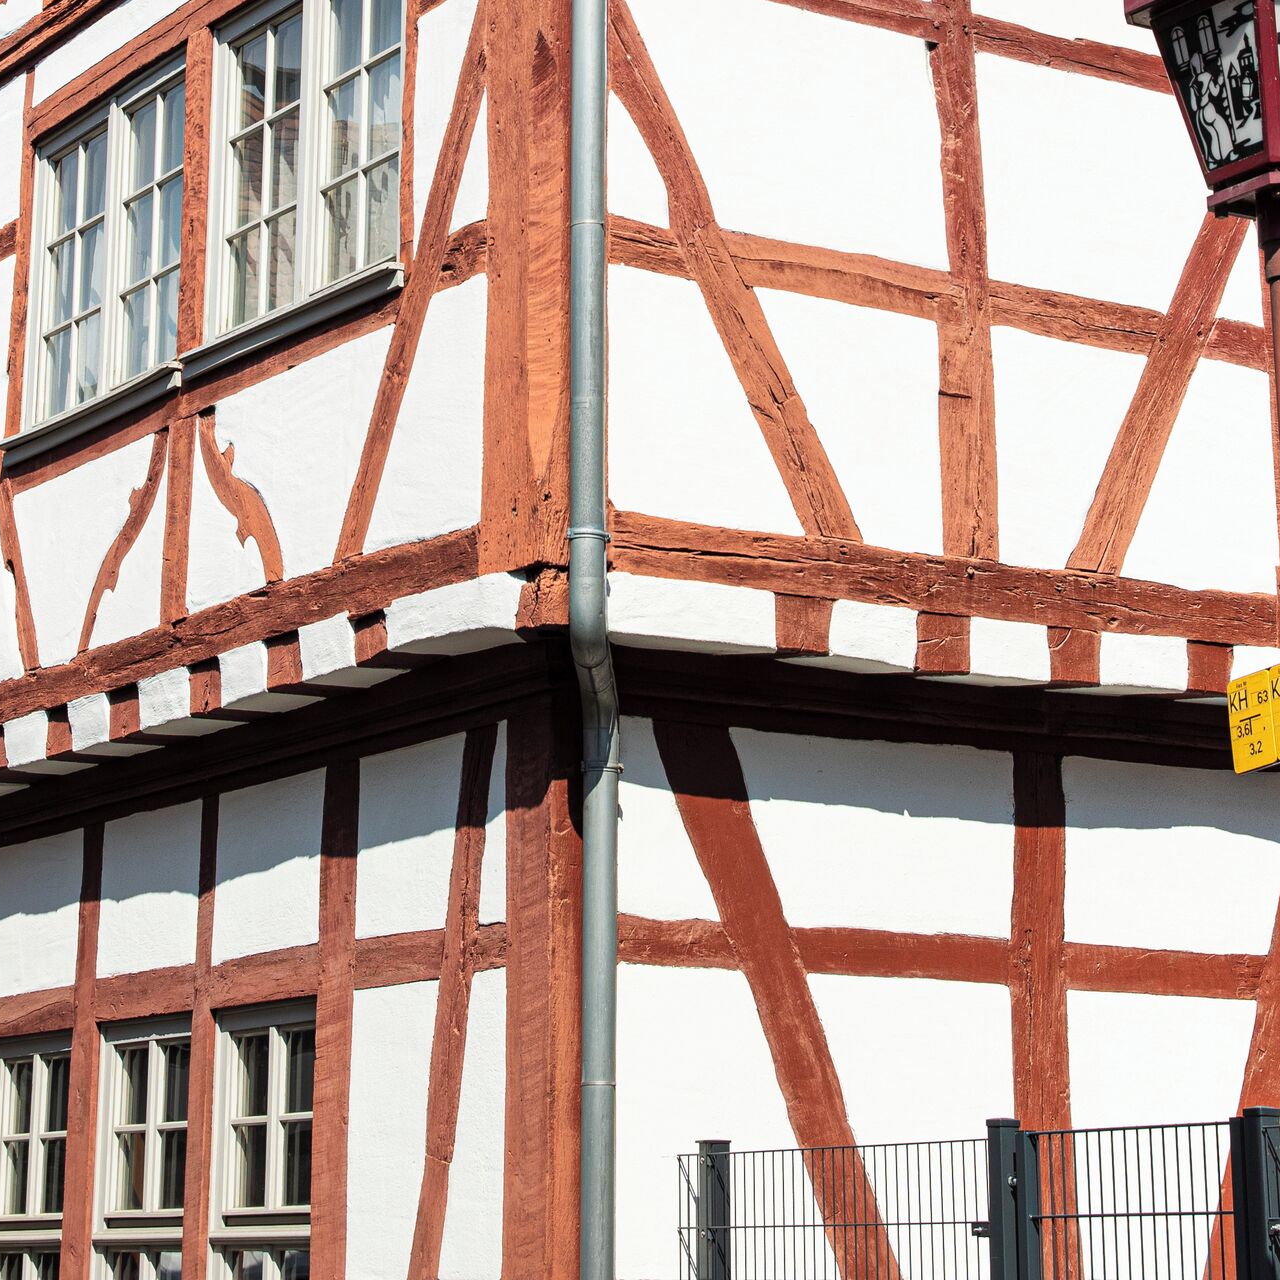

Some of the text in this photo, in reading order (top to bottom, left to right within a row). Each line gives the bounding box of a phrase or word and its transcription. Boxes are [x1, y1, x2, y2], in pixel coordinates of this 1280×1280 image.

[1229, 689, 1269, 714] KH 63
[1236, 723, 1250, 738] 3,6
[1249, 740, 1263, 756] 3,2
